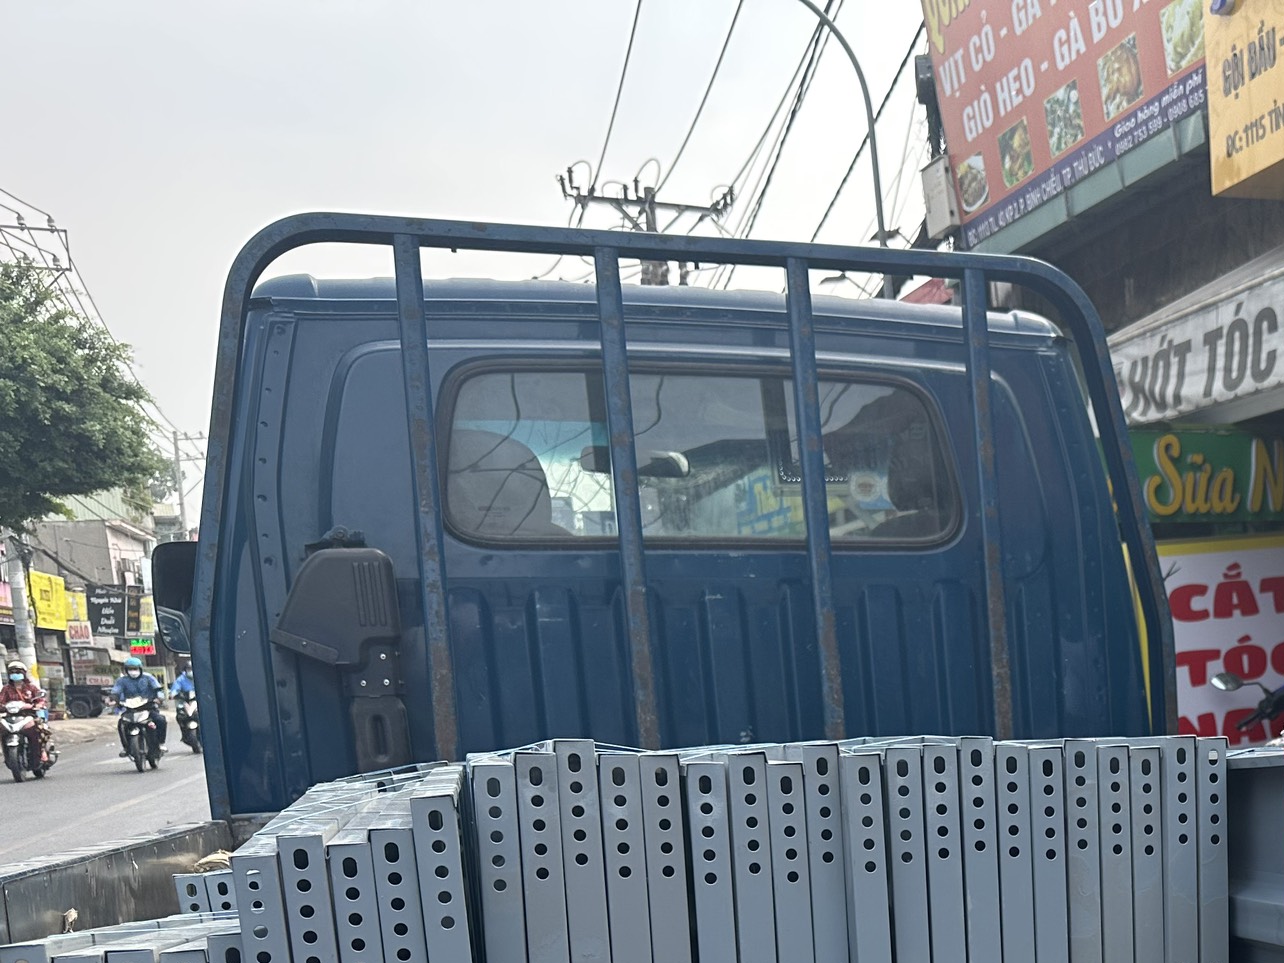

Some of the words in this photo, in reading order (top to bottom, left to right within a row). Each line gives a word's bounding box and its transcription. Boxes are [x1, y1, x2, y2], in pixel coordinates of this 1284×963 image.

[939, 49, 966, 98] VỊT
[969, 9, 995, 72] CỎ
[962, 84, 994, 142] GIÒ
[995, 58, 1035, 117] HEO
[1053, 11, 1086, 71] GÀ
[1125, 333, 1192, 418] HỚT
[1203, 301, 1279, 399] TÓC
[1143, 434, 1240, 516] Sữa
